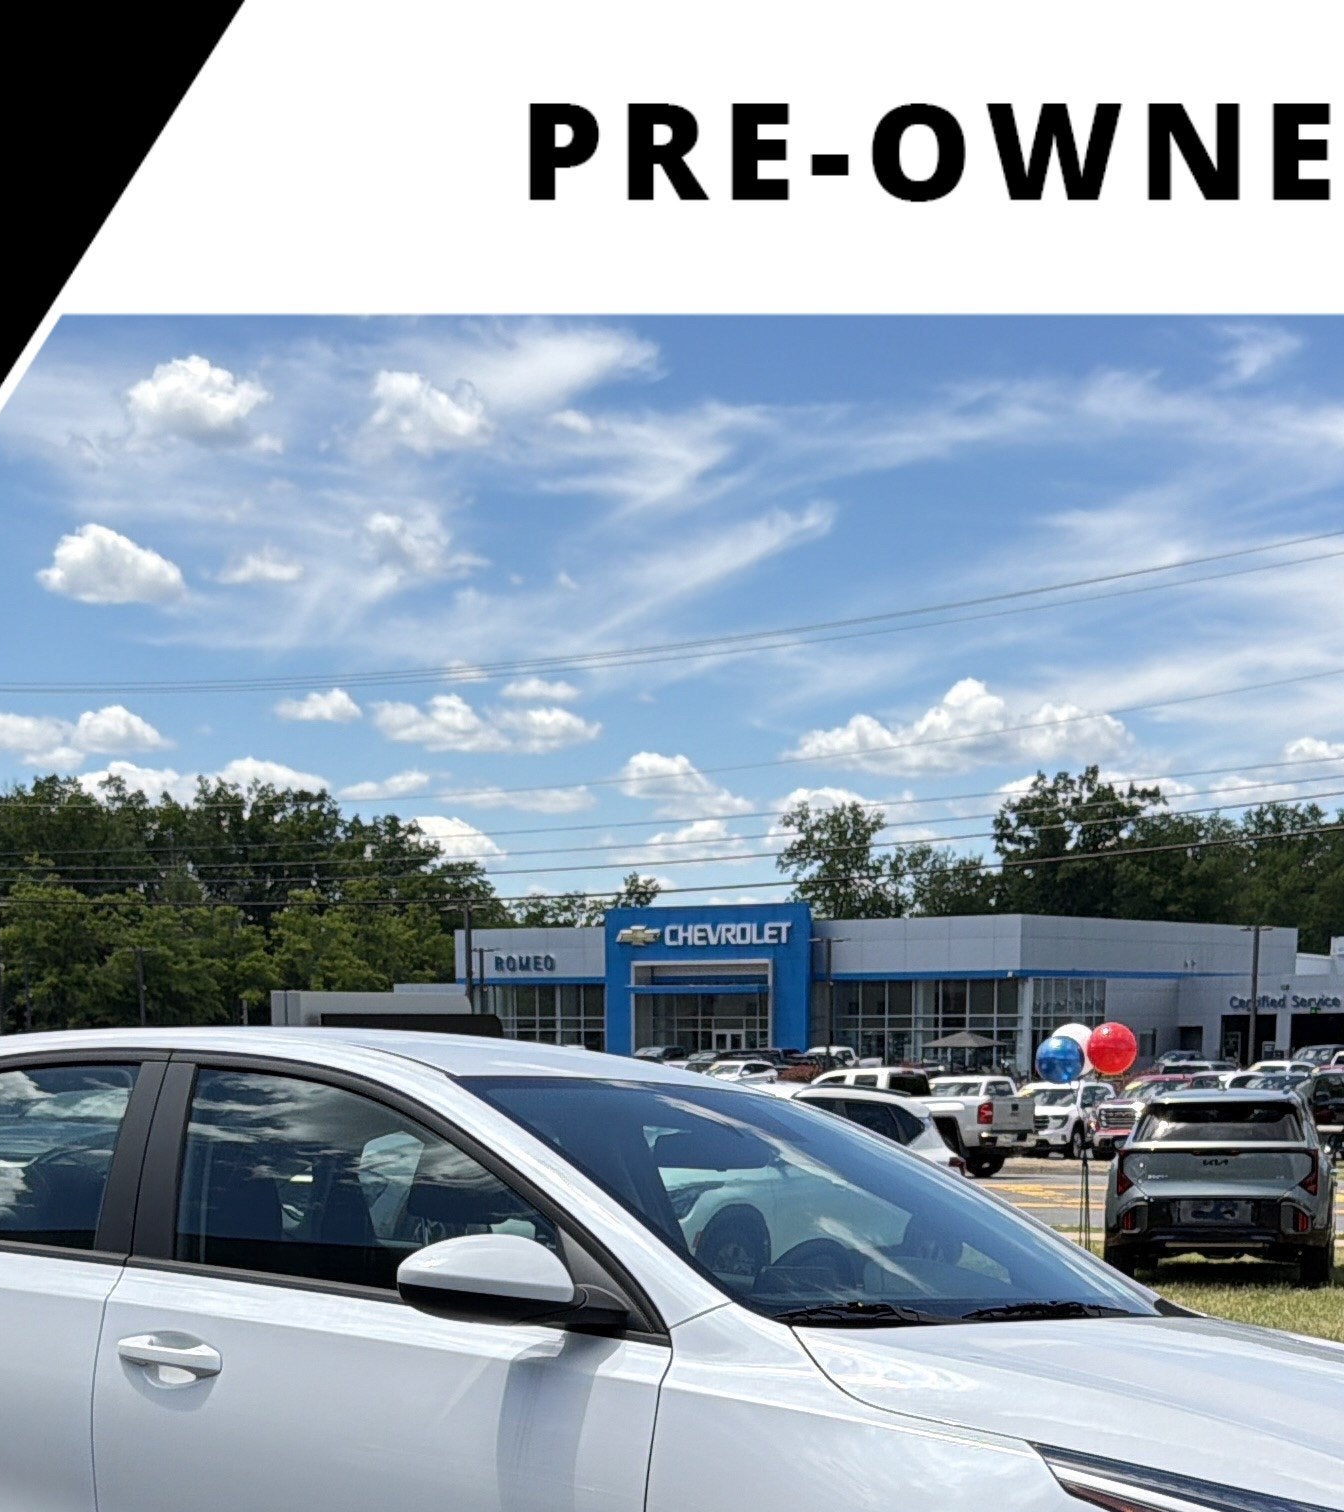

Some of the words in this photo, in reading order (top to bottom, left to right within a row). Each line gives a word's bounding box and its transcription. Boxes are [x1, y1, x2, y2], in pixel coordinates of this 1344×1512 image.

[664, 921, 791, 946] CHEVROLET
[494, 954, 555, 972] ROMEO
[1291, 995, 1341, 1008] Service
